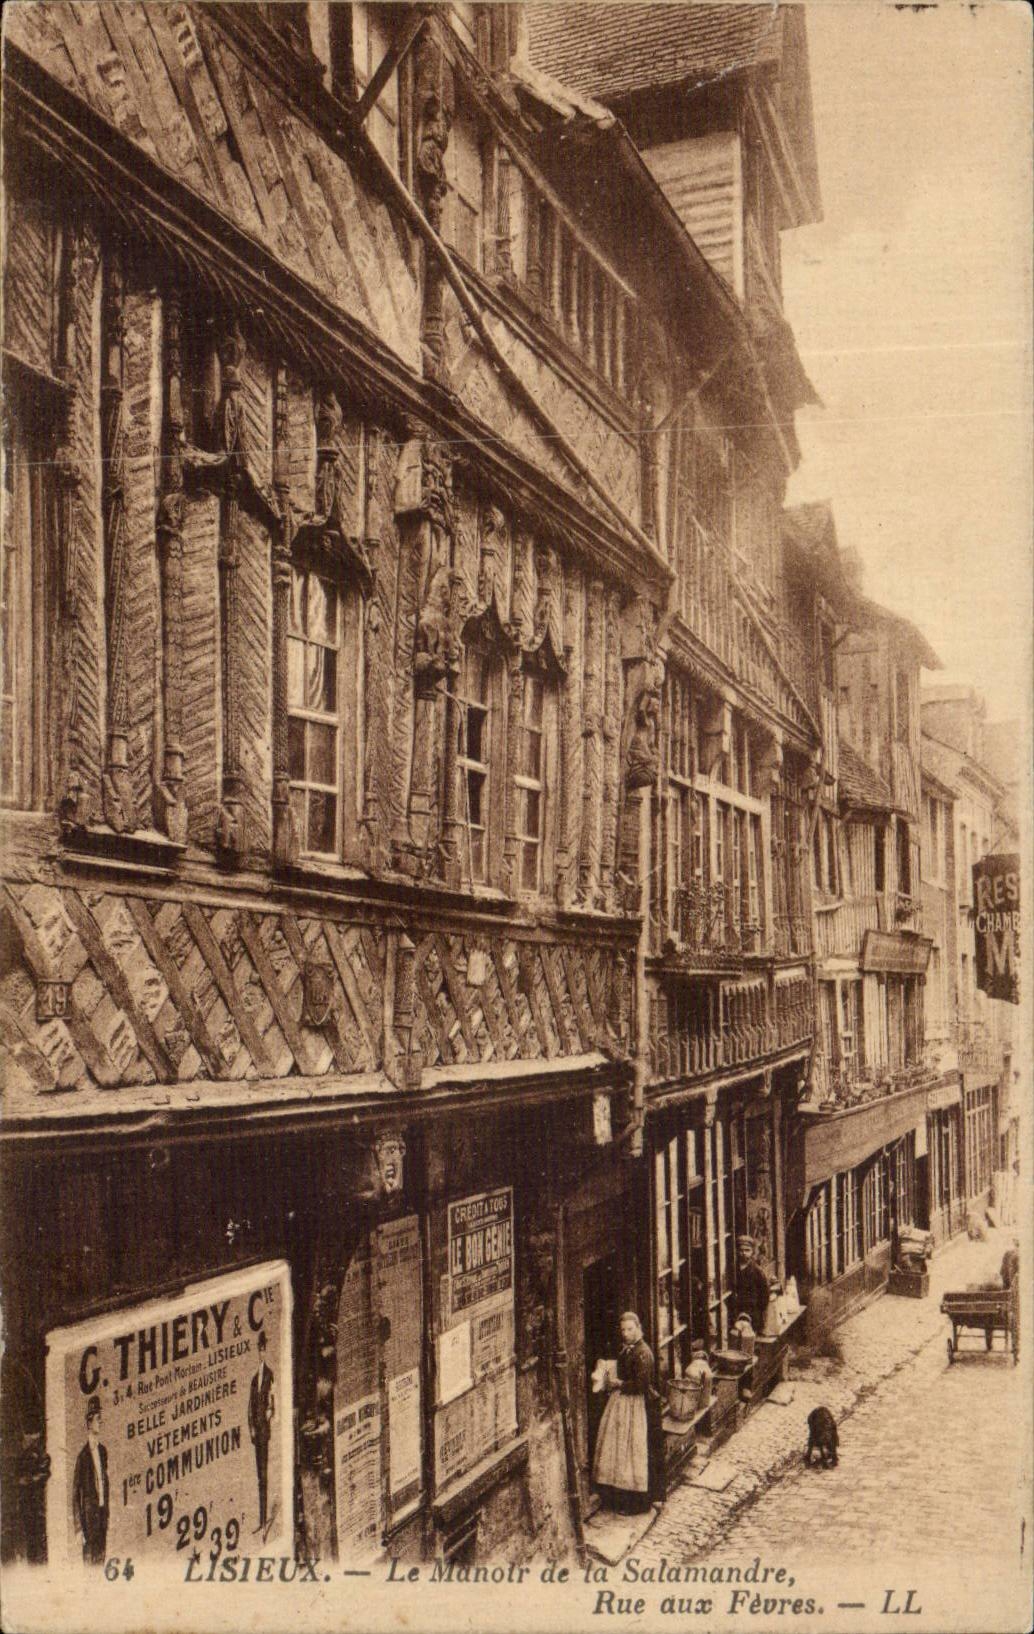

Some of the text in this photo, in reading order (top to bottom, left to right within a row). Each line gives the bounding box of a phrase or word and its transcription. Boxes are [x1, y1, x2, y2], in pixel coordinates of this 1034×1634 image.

[451, 1238, 463, 1276] LE
[465, 1230, 484, 1271] BON
[78, 1346, 109, 1396] G.
[208, 1339, 251, 1367] LISIEUX
[127, 1410, 166, 1440] BELLE
[145, 1425, 242, 1495] COMMUNION
